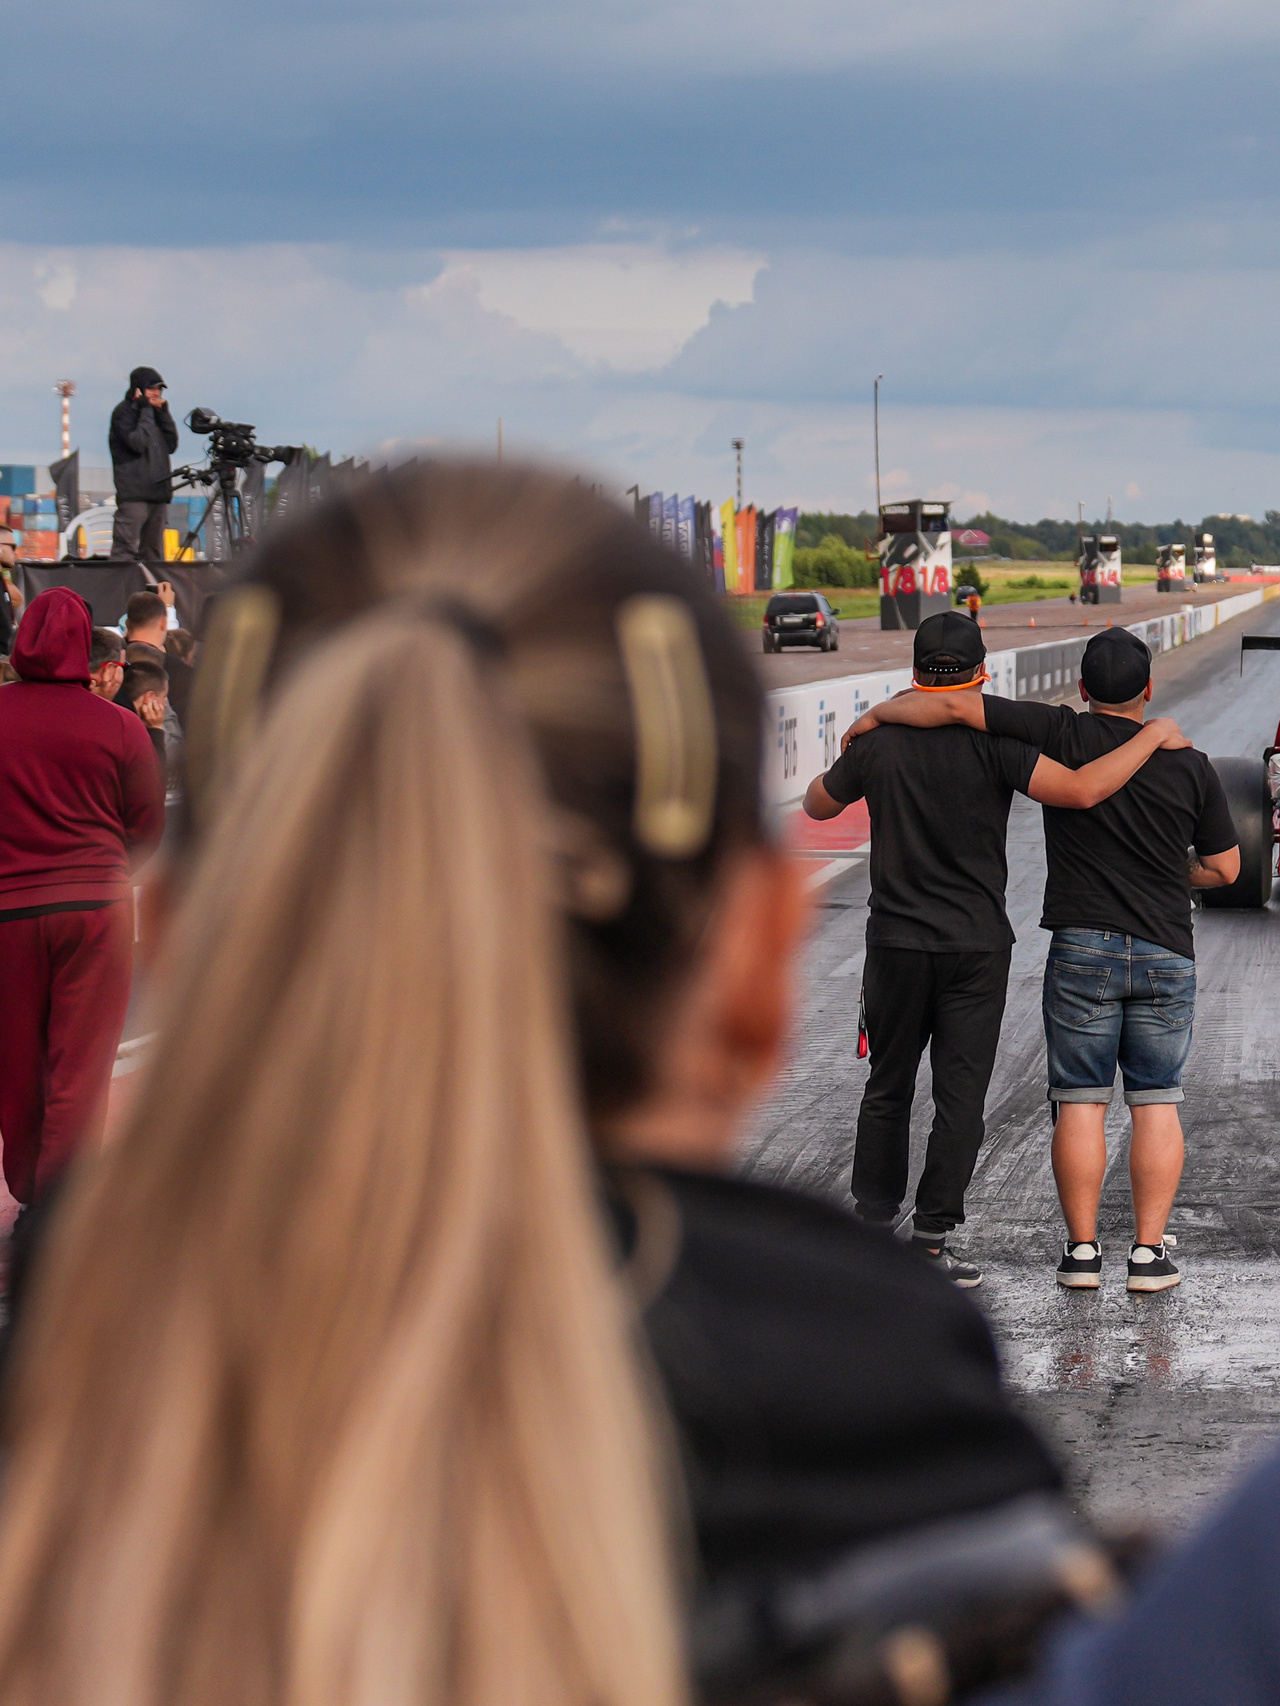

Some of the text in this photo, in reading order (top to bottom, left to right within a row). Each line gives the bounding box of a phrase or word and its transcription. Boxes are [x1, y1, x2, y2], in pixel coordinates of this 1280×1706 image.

[880, 565, 916, 597] 1/8
[920, 565, 949, 597] 1/8
[784, 717, 797, 779] ВТБ
